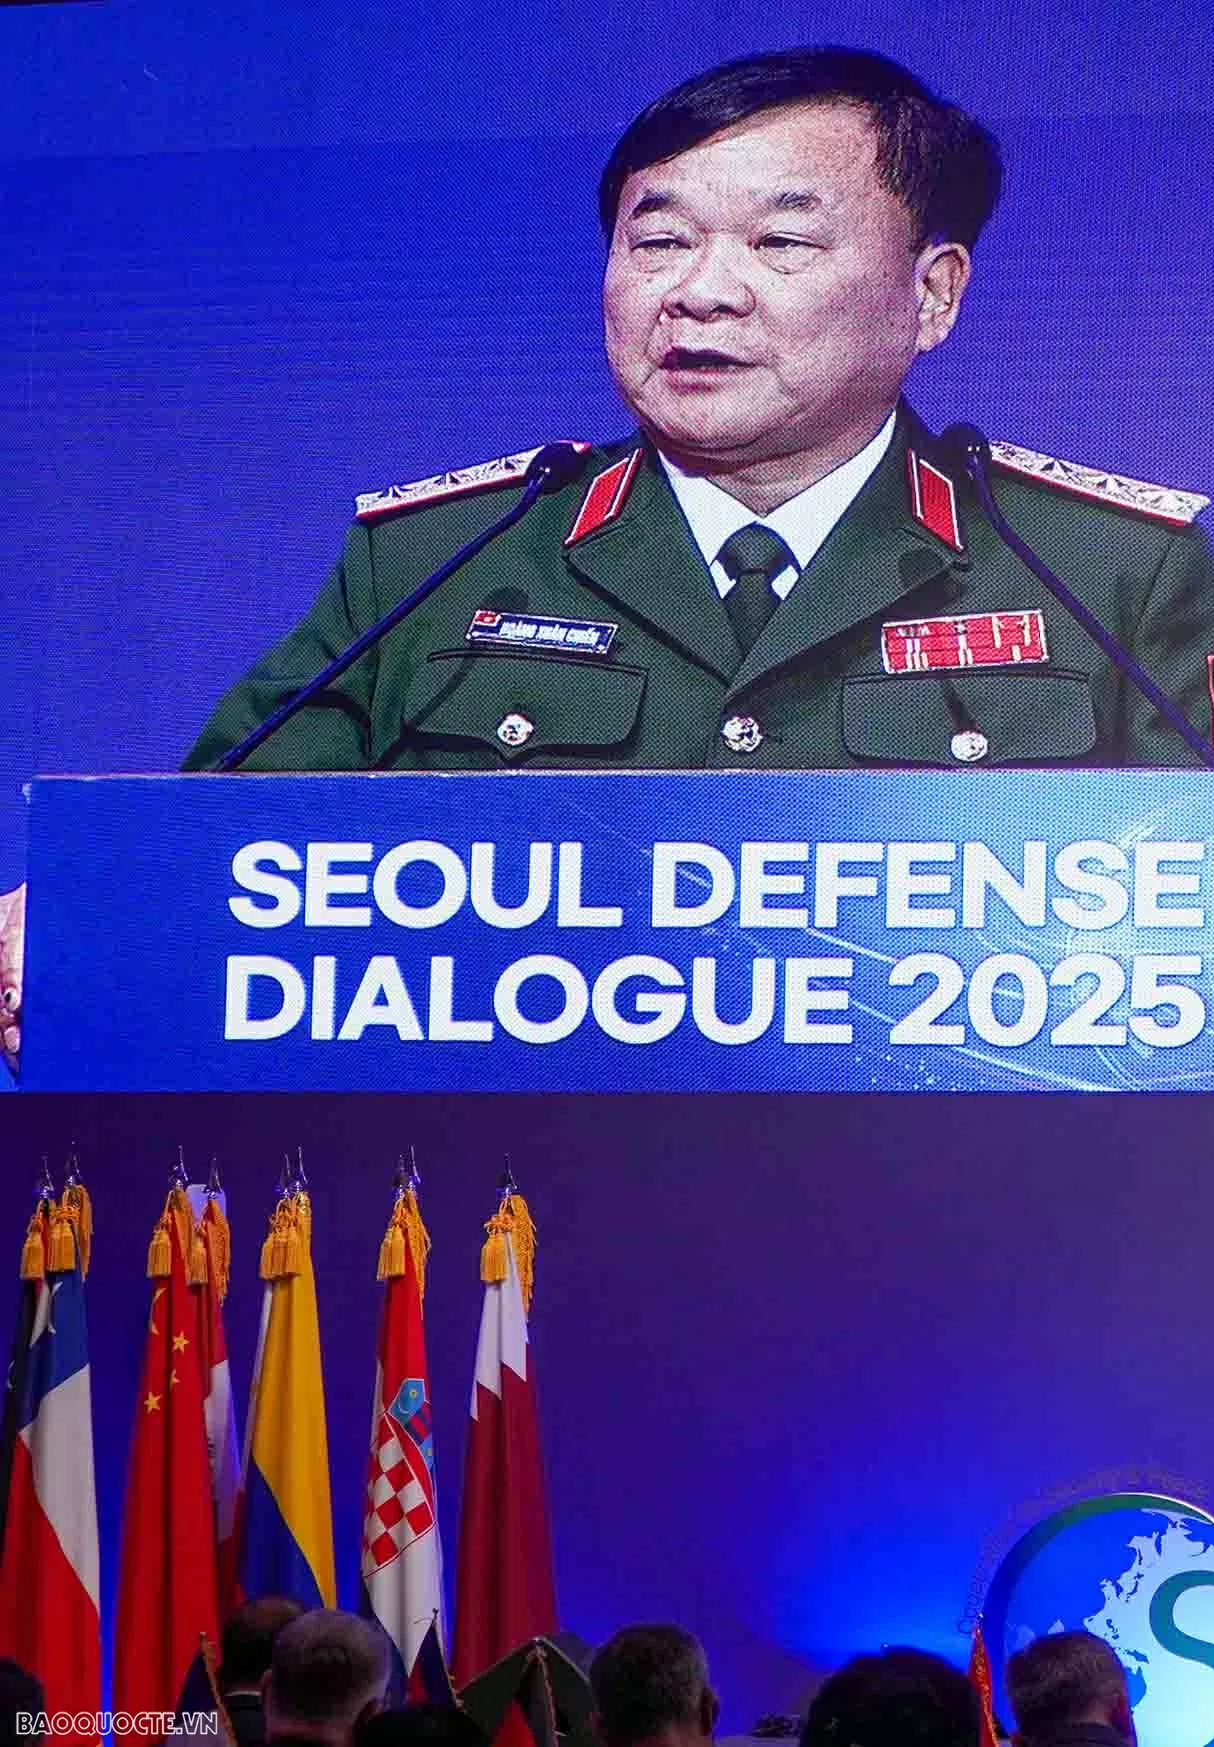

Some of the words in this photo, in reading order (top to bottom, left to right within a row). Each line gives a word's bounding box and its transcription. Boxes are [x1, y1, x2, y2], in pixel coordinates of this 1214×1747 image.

[227, 841, 623, 929] SEOUL
[650, 840, 1207, 930] DEFENSE
[224, 955, 854, 1045] DIALOGUE
[888, 954, 1207, 1048] 2025
